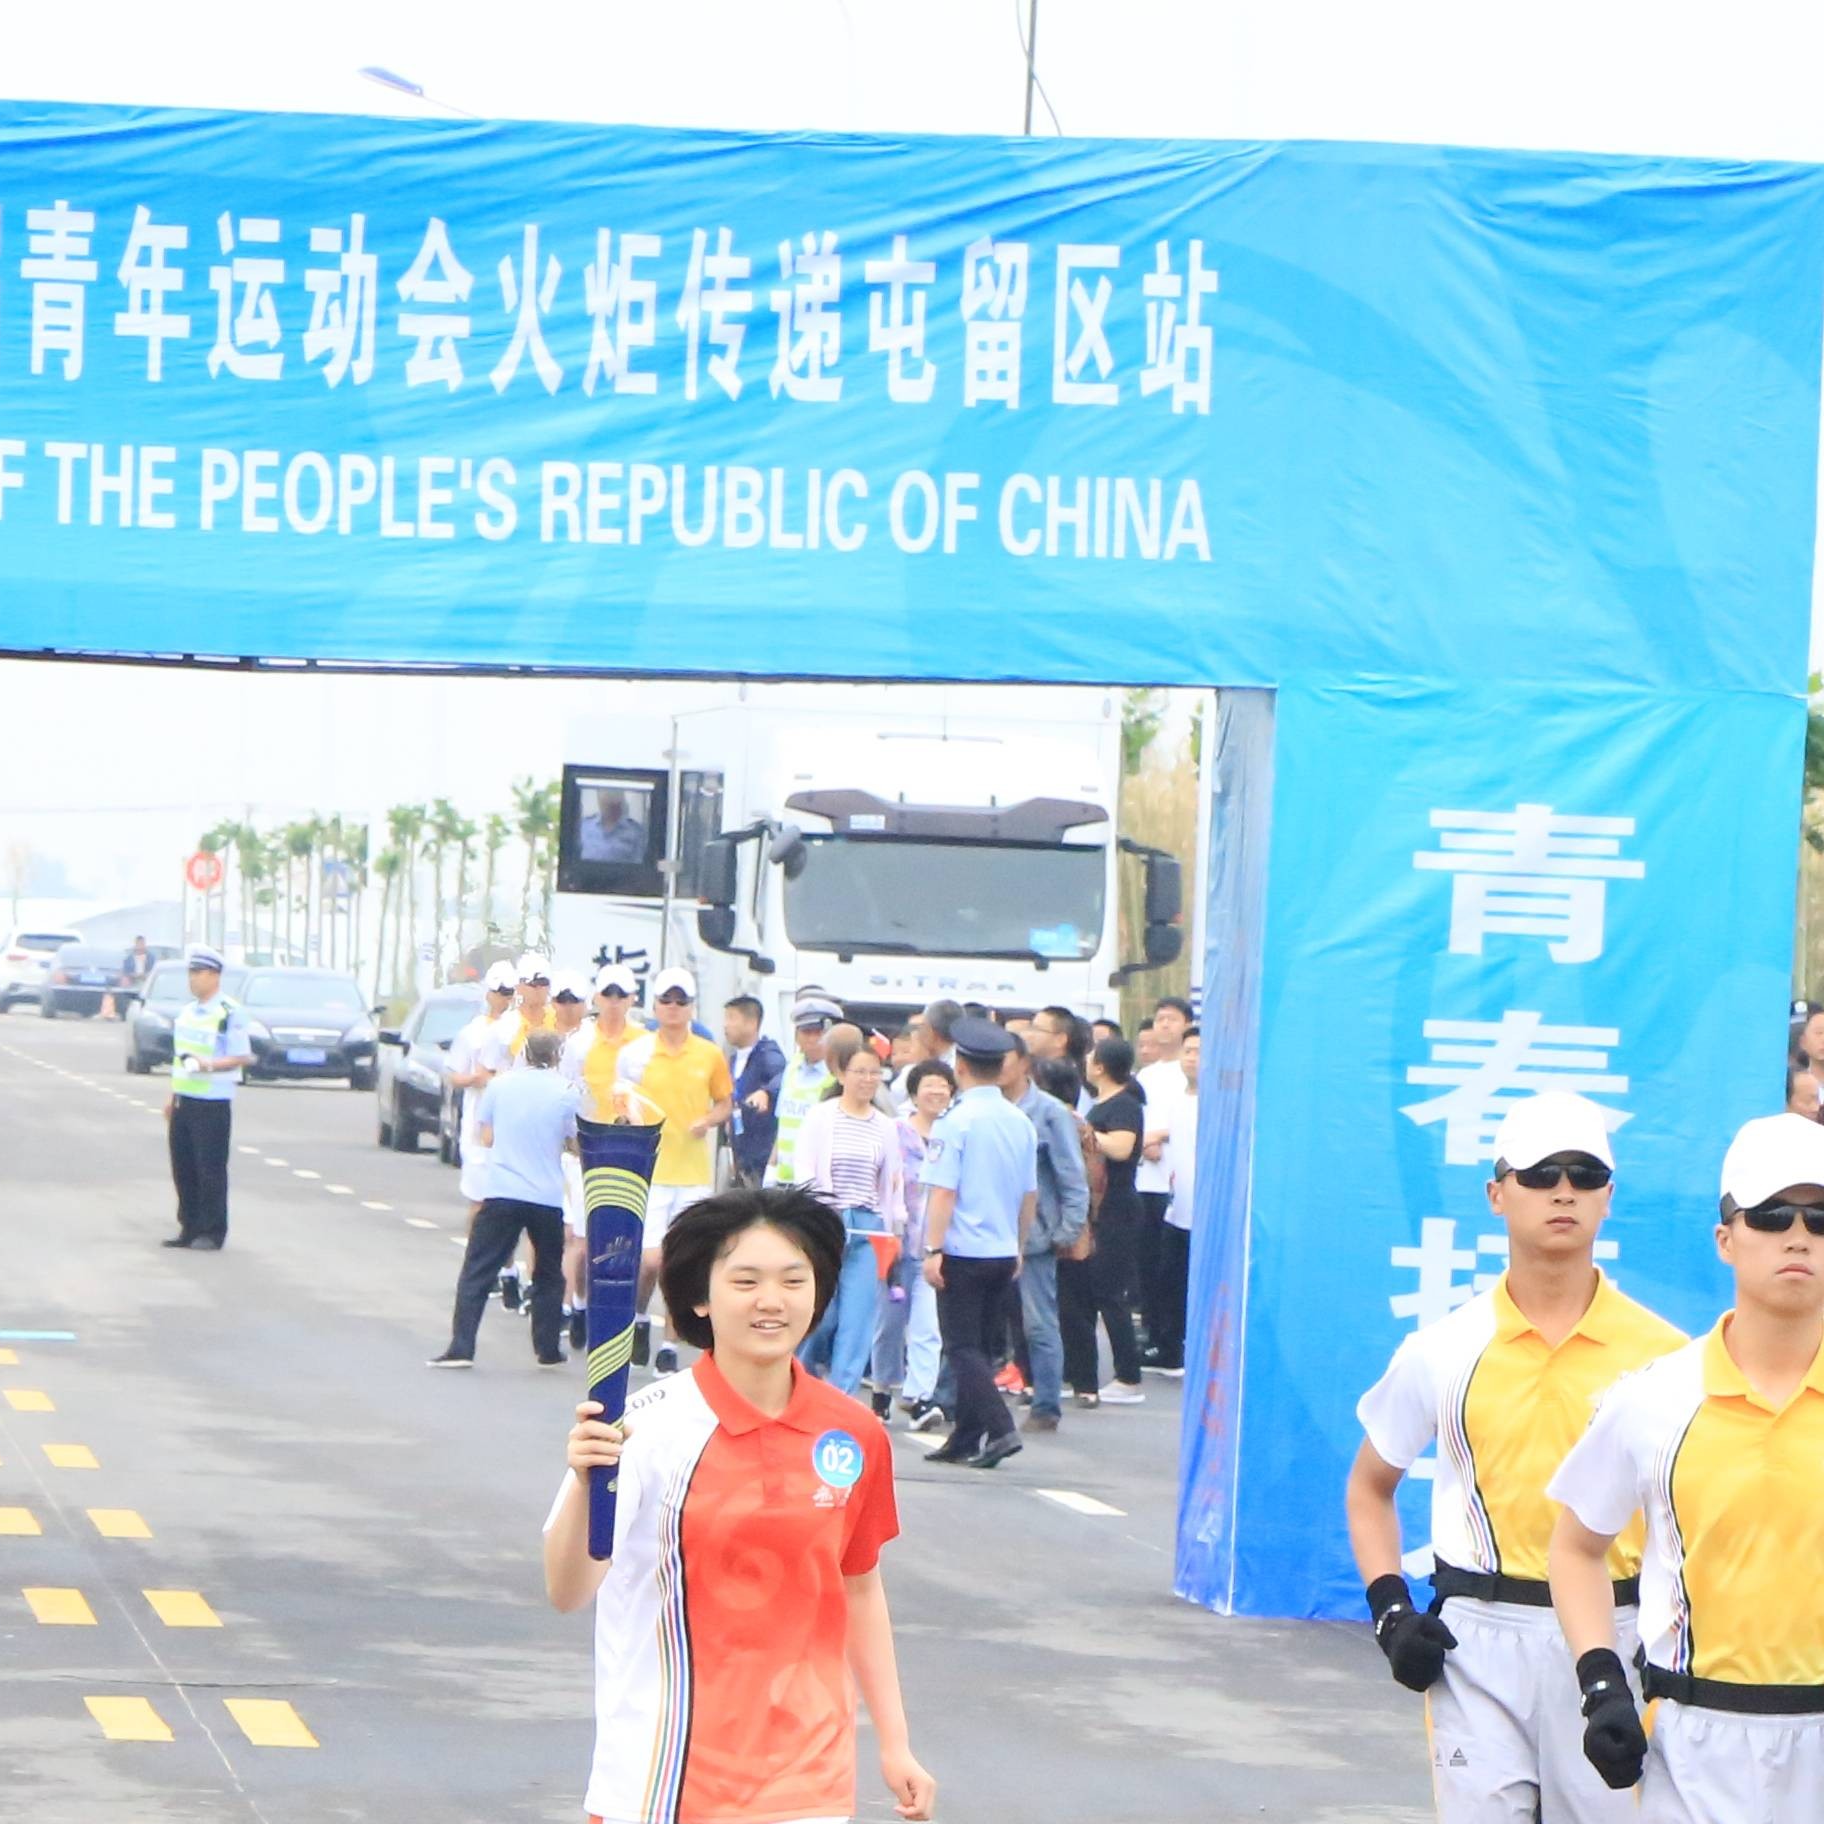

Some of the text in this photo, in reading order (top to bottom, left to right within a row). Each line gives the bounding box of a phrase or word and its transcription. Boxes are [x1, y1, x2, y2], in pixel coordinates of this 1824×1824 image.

[44, 440, 176, 529] THE
[200, 446, 518, 541] PEOPLE'S
[540, 461, 868, 551] REPUBLIC
[890, 469, 978, 554] OF
[997, 472, 1211, 561] CHINA
[822, 1447, 853, 1475] 02
